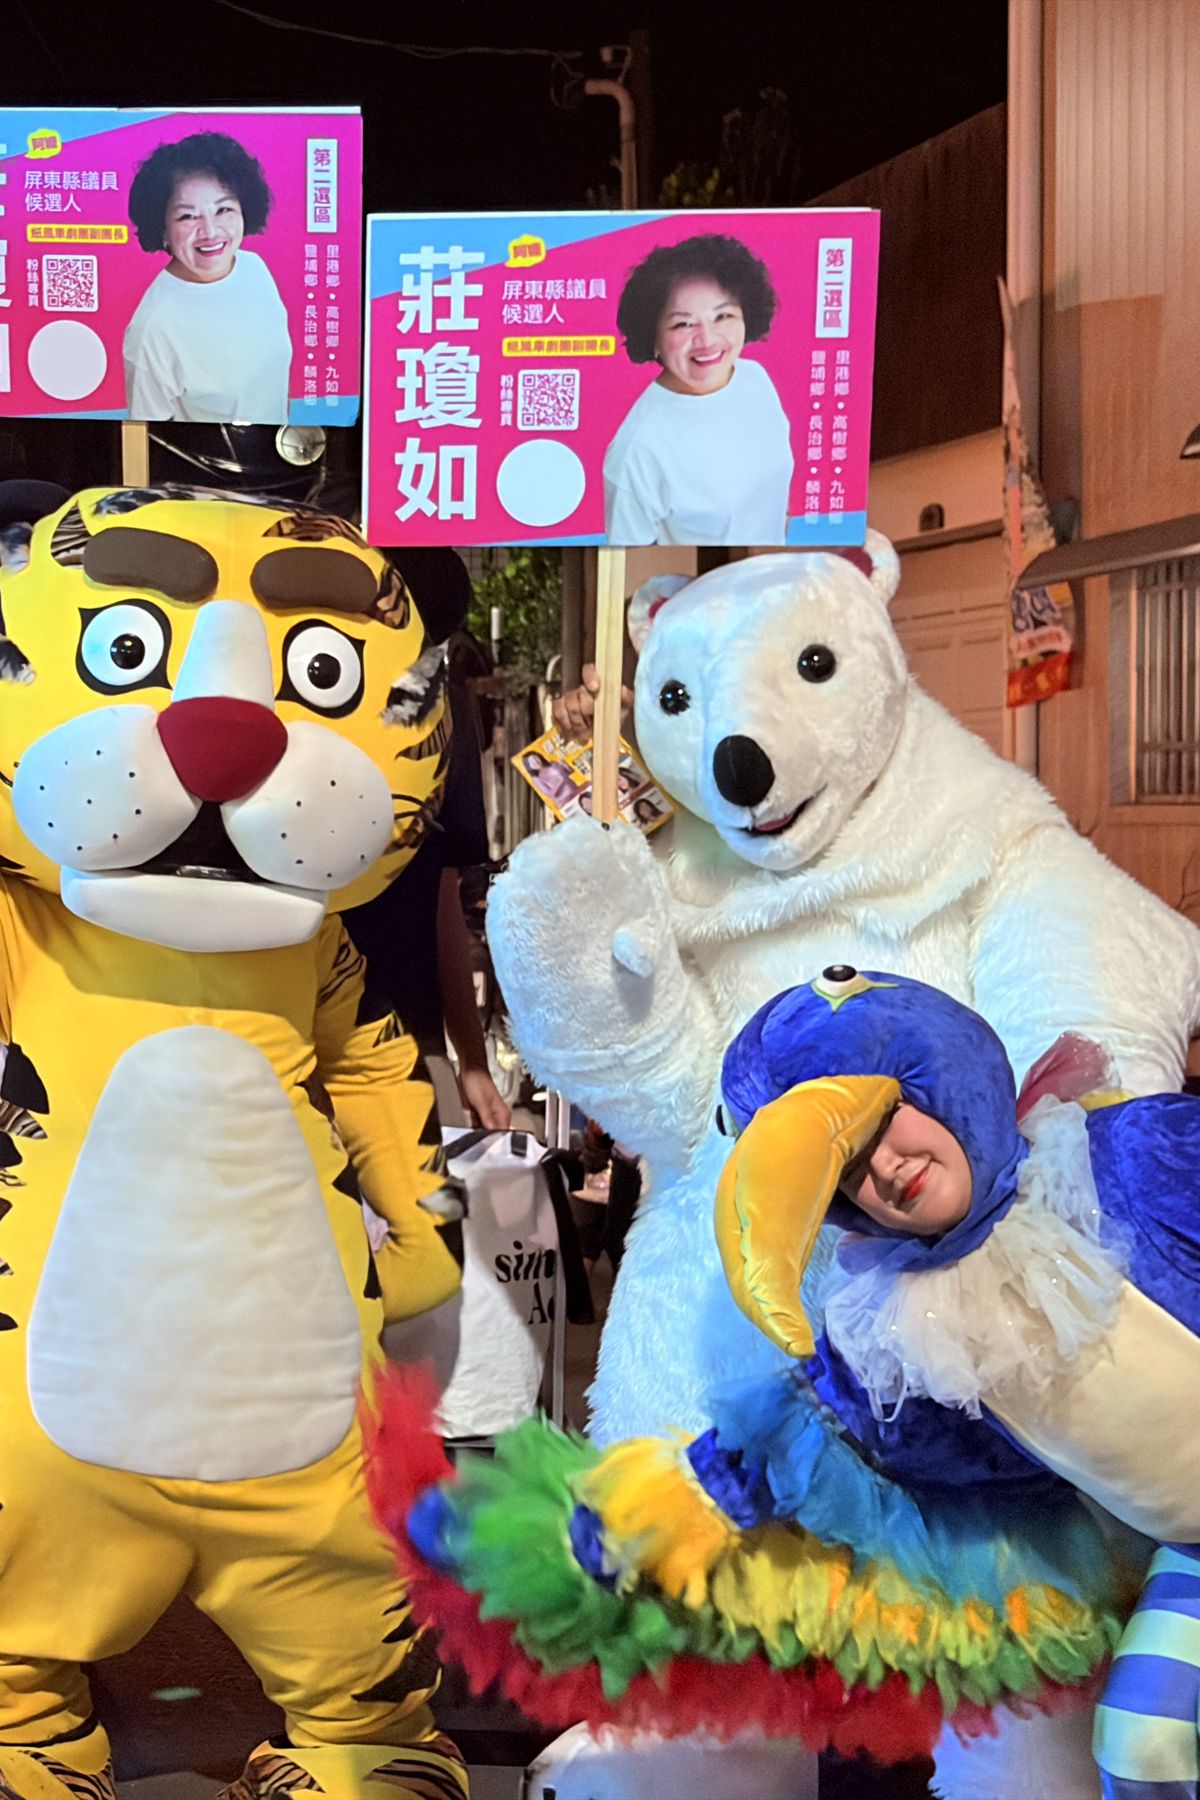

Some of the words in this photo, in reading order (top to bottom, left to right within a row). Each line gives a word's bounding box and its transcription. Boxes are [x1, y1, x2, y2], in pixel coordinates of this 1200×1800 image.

[24, 170, 120, 191] 屏東縣議員
[313, 148, 331, 224] 第二選區
[24, 192, 82, 213] 候選人
[501, 278, 608, 301] 屏東縣議員
[822, 248, 845, 328] 第二選區
[501, 302, 565, 325] 候選人
[394, 245, 485, 523] 莊瓊如
